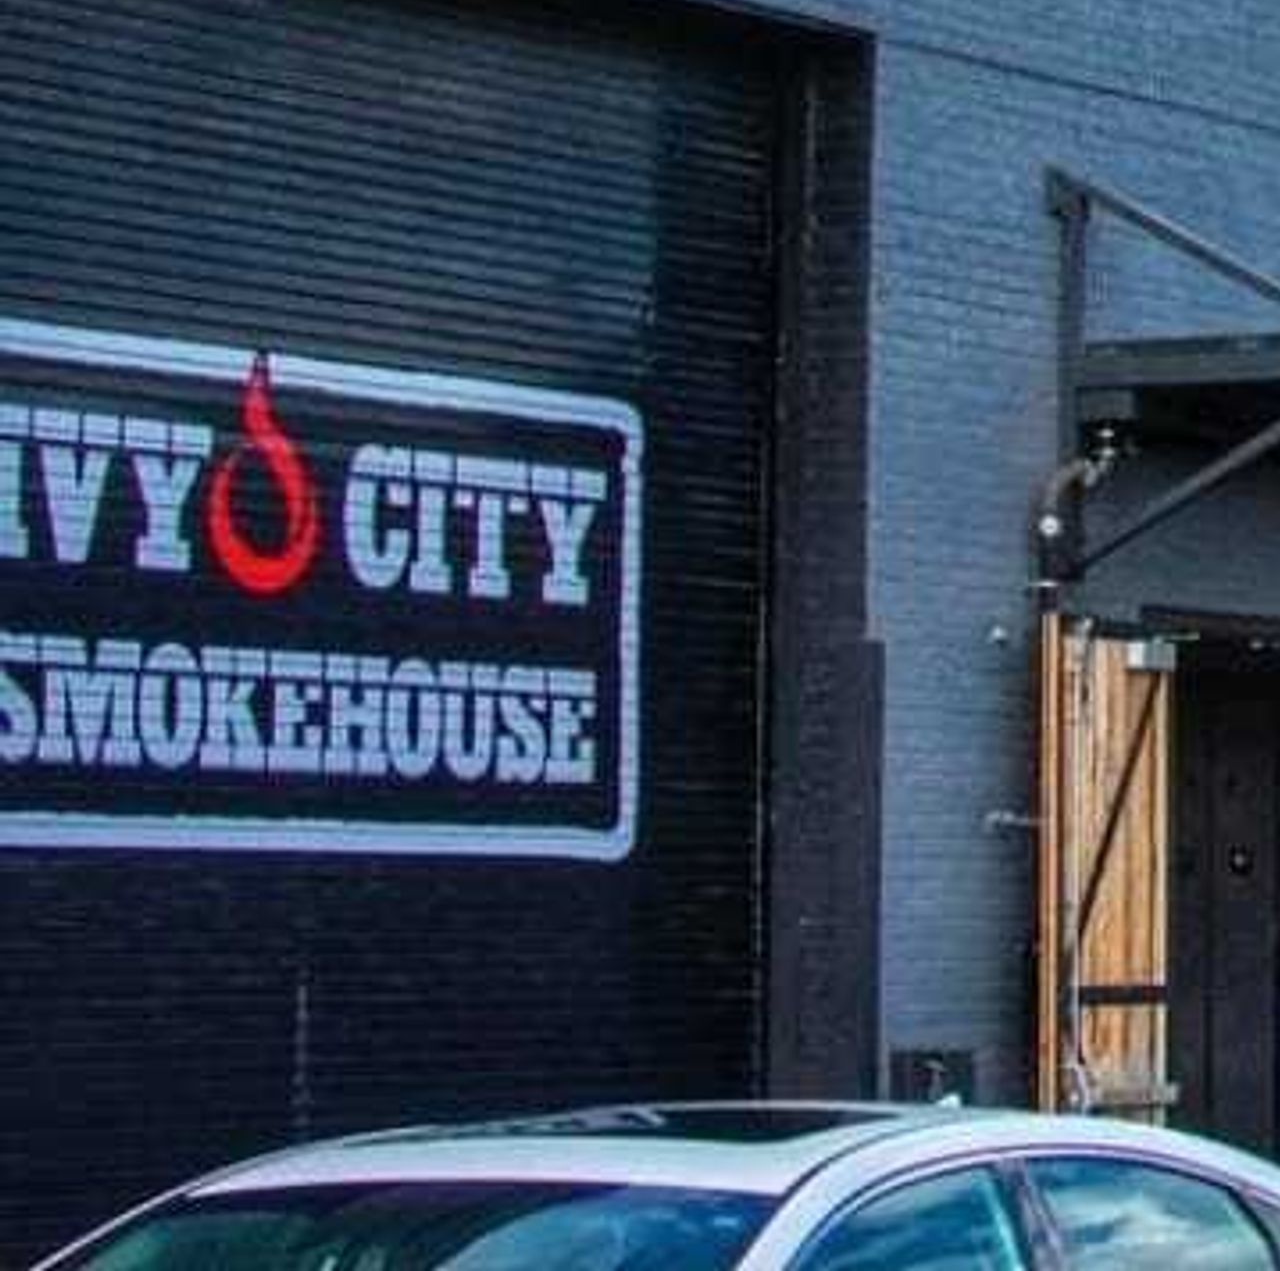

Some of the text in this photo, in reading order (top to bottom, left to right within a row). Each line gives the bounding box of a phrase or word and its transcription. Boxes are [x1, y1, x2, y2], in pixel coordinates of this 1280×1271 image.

[0, 403, 606, 605] IVY CITY
[0, 634, 597, 784] SMOKEHOUSE
